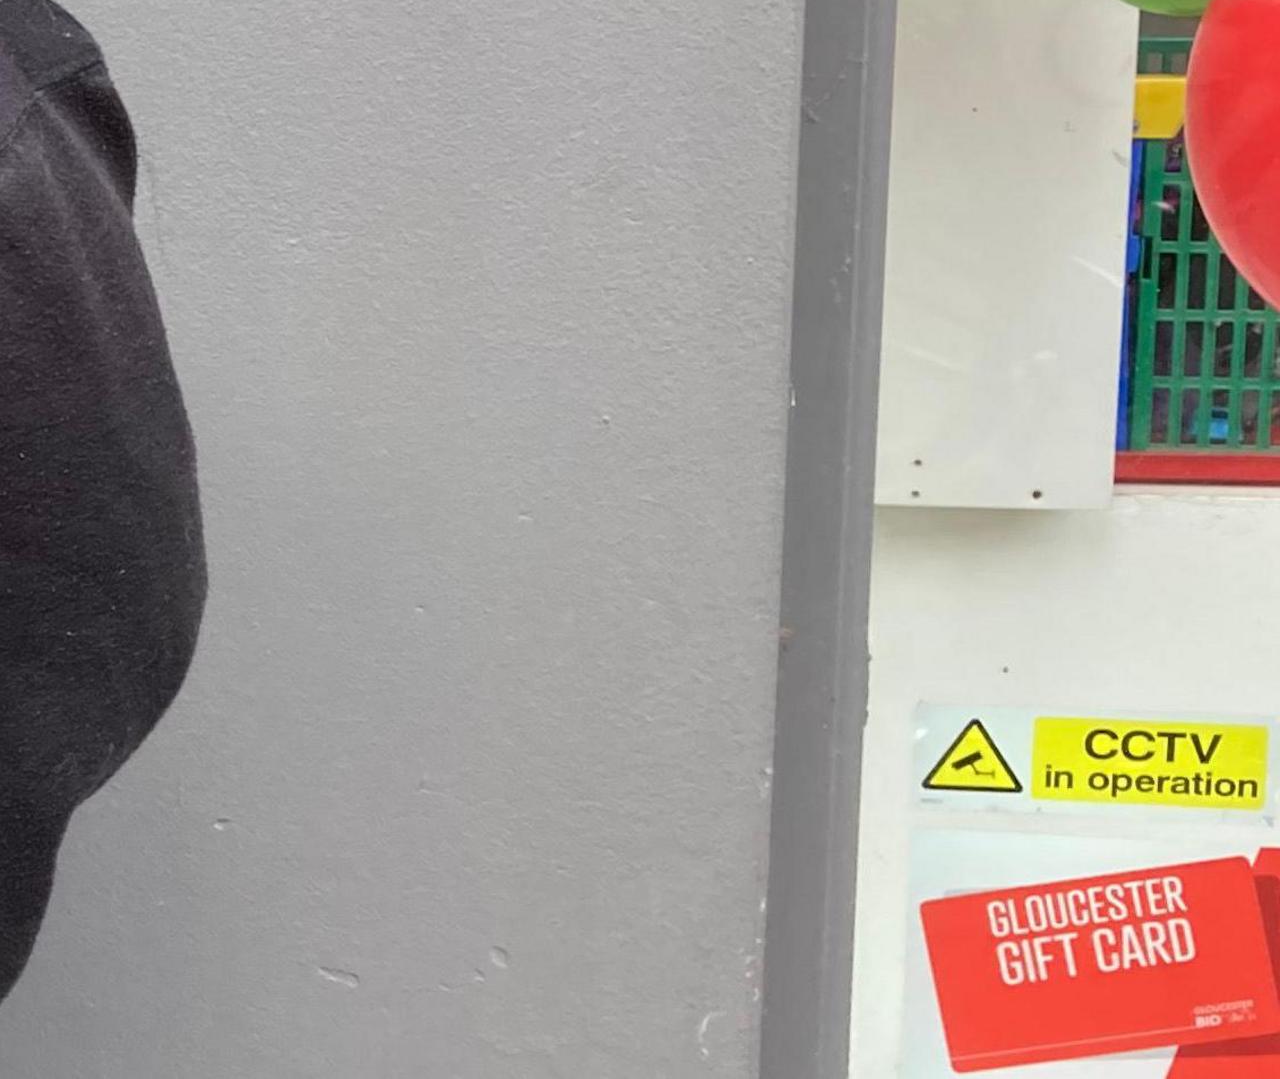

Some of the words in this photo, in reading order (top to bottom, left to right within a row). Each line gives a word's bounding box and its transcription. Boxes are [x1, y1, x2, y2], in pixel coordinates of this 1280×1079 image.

[1083, 729, 1223, 765] CCTV
[1044, 763, 1074, 789] in
[1087, 769, 1259, 799] operation
[985, 875, 1189, 939] GLOUCESTER
[995, 931, 1080, 987] GIFT
[1090, 917, 1197, 974] CARD
[1195, 1014, 1223, 1029] BID
